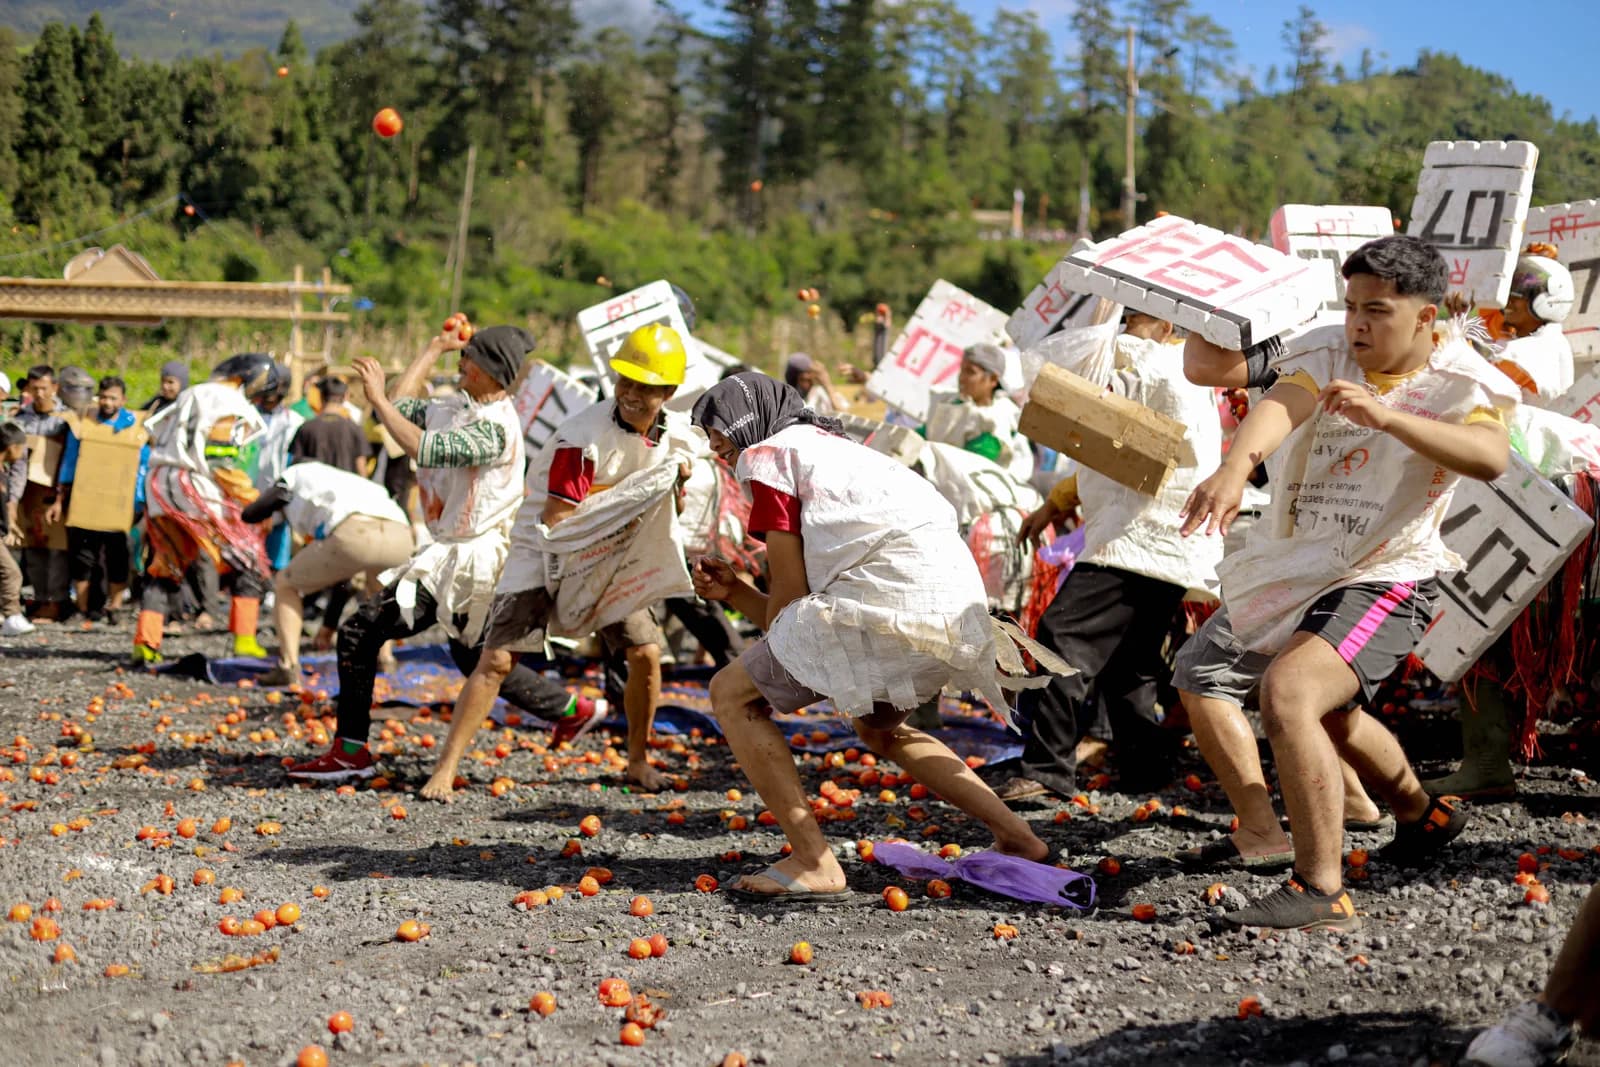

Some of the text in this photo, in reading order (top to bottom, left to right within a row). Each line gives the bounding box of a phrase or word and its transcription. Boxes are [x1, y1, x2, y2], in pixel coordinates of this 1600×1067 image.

[1315, 218, 1355, 248] RT
[1548, 213, 1585, 243] RT
[1144, 240, 1270, 297] 07
[605, 294, 641, 328] RT
[940, 300, 977, 327] RT
[1034, 281, 1072, 325] RT
[895, 326, 965, 386] 07
[1313, 444, 1346, 458] JAP
